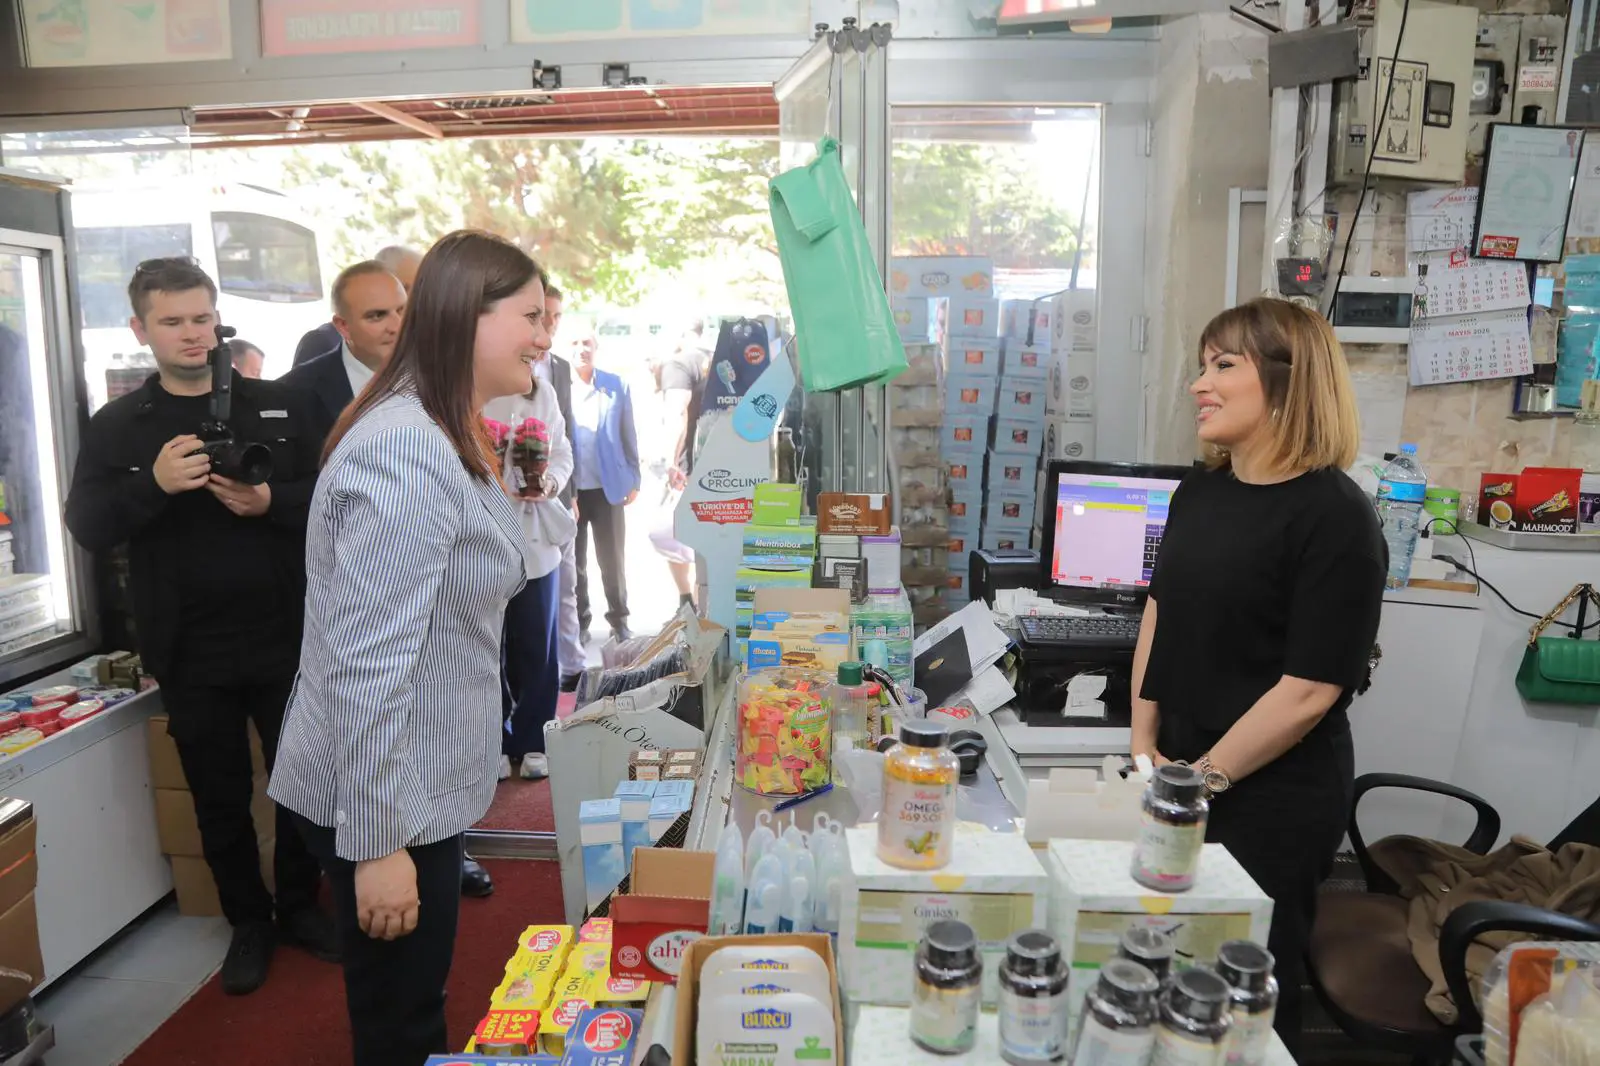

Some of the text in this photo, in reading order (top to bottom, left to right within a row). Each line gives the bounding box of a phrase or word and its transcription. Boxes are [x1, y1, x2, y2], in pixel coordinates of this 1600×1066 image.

[1448, 330, 1472, 338] MAYIS
[1522, 523, 1571, 532] MAHMOOD
[755, 540, 801, 549] Mentholbox
[535, 954, 553, 973] TON
[480, 1013, 502, 1040] PAKET
[504, 1013, 533, 1039] 3+1
[744, 1012, 788, 1027] BURCU
